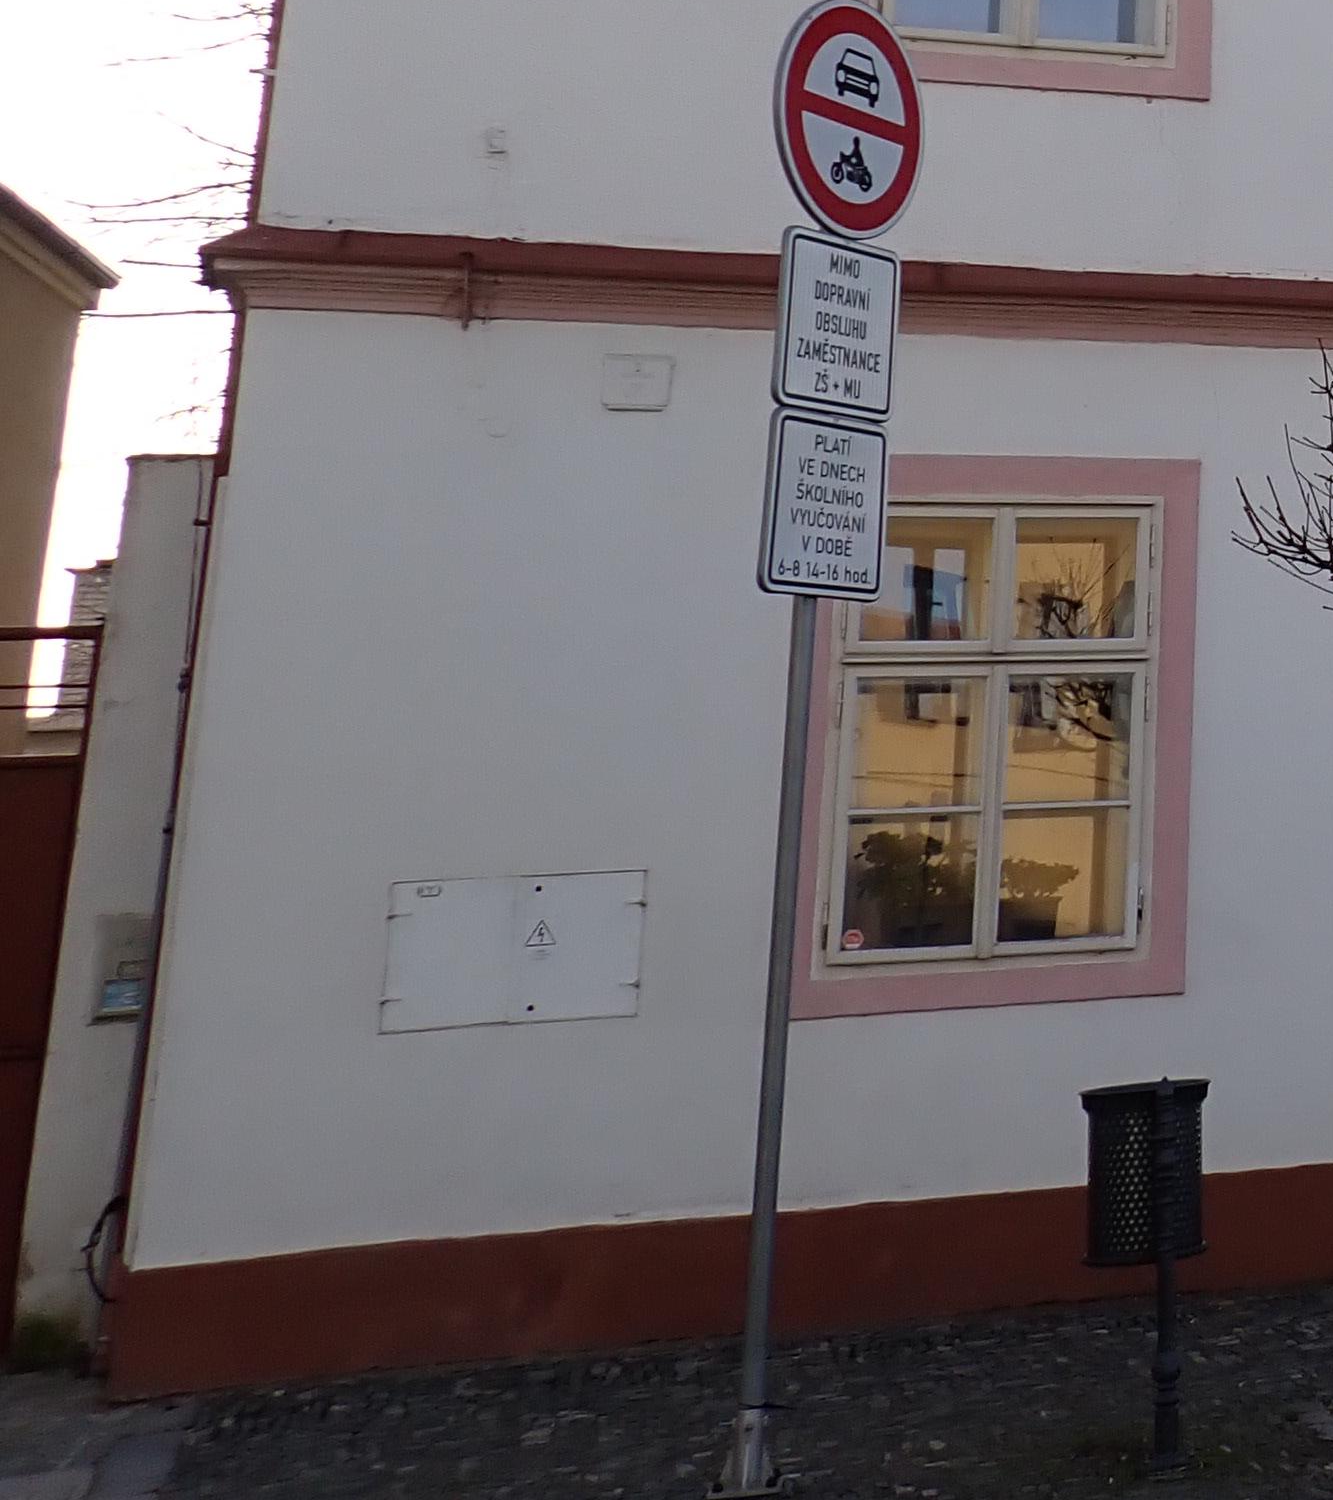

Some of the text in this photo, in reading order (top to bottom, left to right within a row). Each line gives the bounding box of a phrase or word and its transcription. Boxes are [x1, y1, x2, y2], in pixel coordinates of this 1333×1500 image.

[829, 253, 861, 279] MIMO
[814, 279, 871, 312] DOPRAVNÍ
[815, 311, 867, 340] OBSLUHU
[796, 337, 881, 374] ZAMĚSTNANCE
[814, 369, 829, 394] ZŠ
[843, 378, 861, 399] MU
[814, 433, 852, 456] PLATÍ
[798, 456, 866, 483] VE DNECH
[795, 478, 864, 509] ŠKOLNÍHO
[790, 506, 866, 534] VYUČOVÁNÍ
[801, 534, 853, 557] V DOBĚ
[777, 558, 872, 586] 6-8 14-16 hod.
